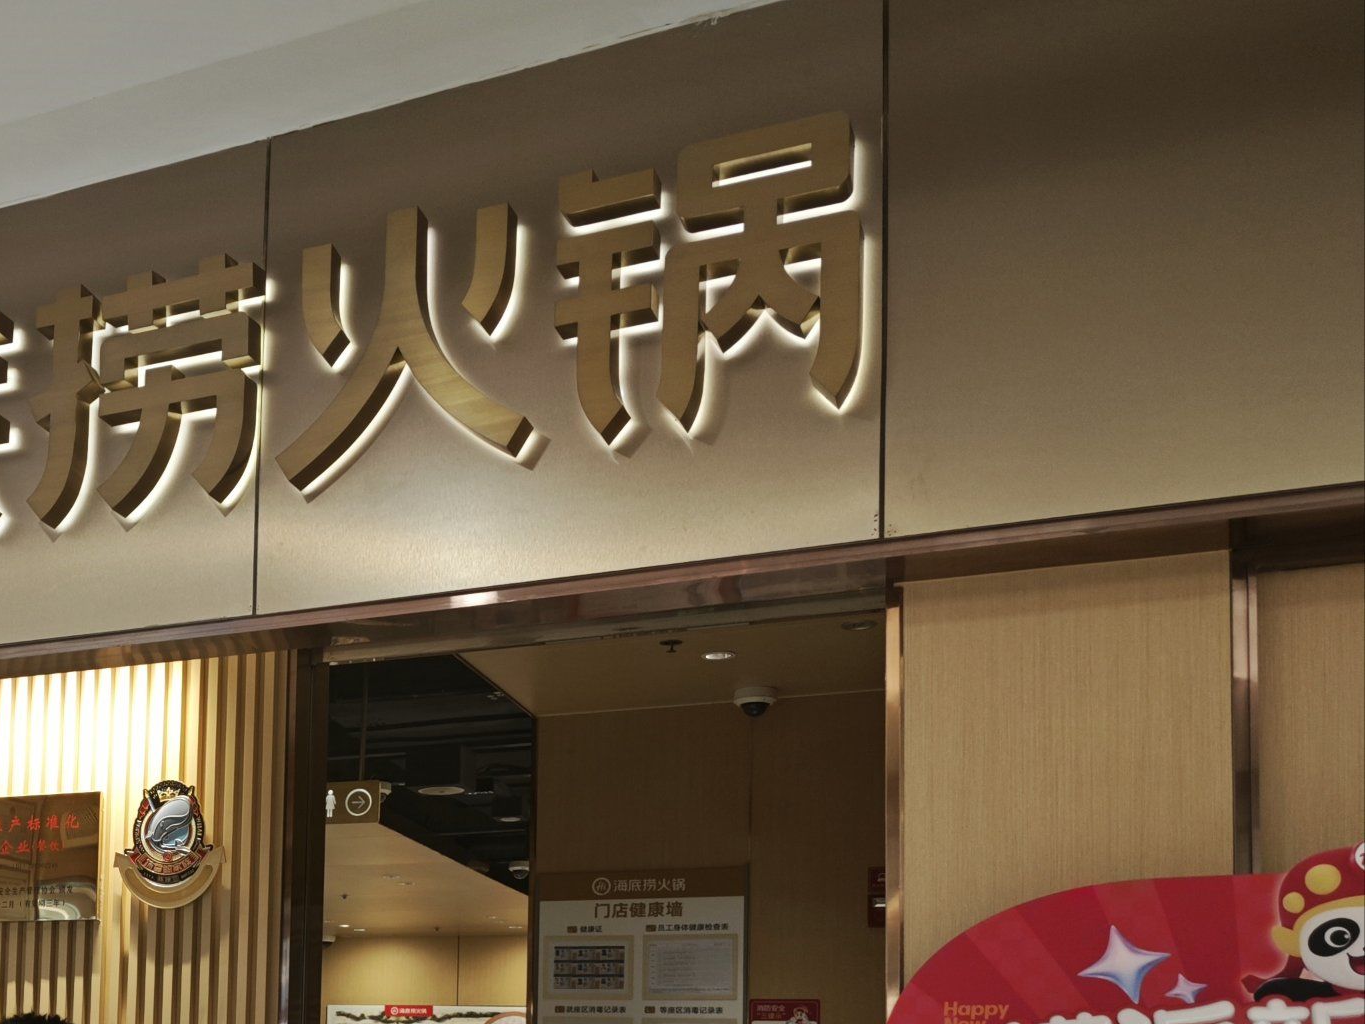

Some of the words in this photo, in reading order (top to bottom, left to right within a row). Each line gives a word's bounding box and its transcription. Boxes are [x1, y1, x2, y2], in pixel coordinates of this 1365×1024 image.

[613, 878, 687, 893] 海底捞火锅
[593, 901, 684, 919] 门店健康墙
[579, 925, 603, 933] 健康证
[944, 1001, 1010, 1020] Happy
